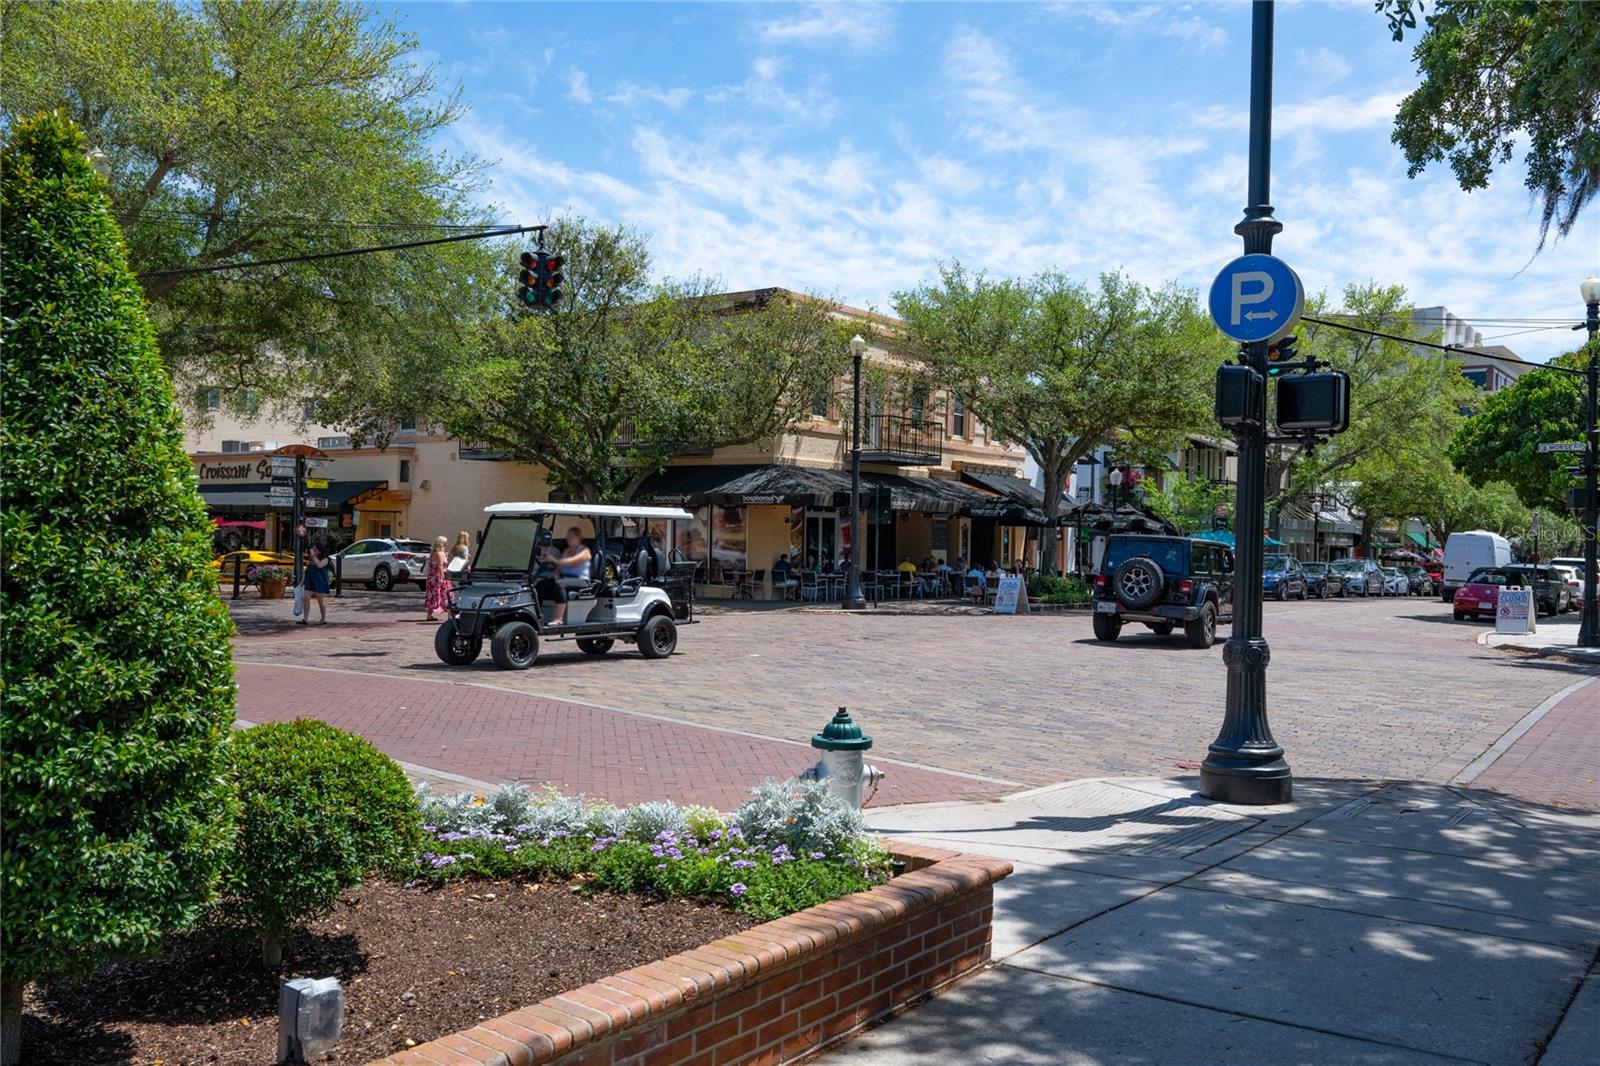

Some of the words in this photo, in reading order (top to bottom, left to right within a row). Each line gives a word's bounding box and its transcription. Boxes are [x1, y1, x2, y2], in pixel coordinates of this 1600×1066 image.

[1231, 271, 1274, 326] P
[200, 463, 252, 480] Croissant
[1500, 594, 1528, 602] CLOSED
